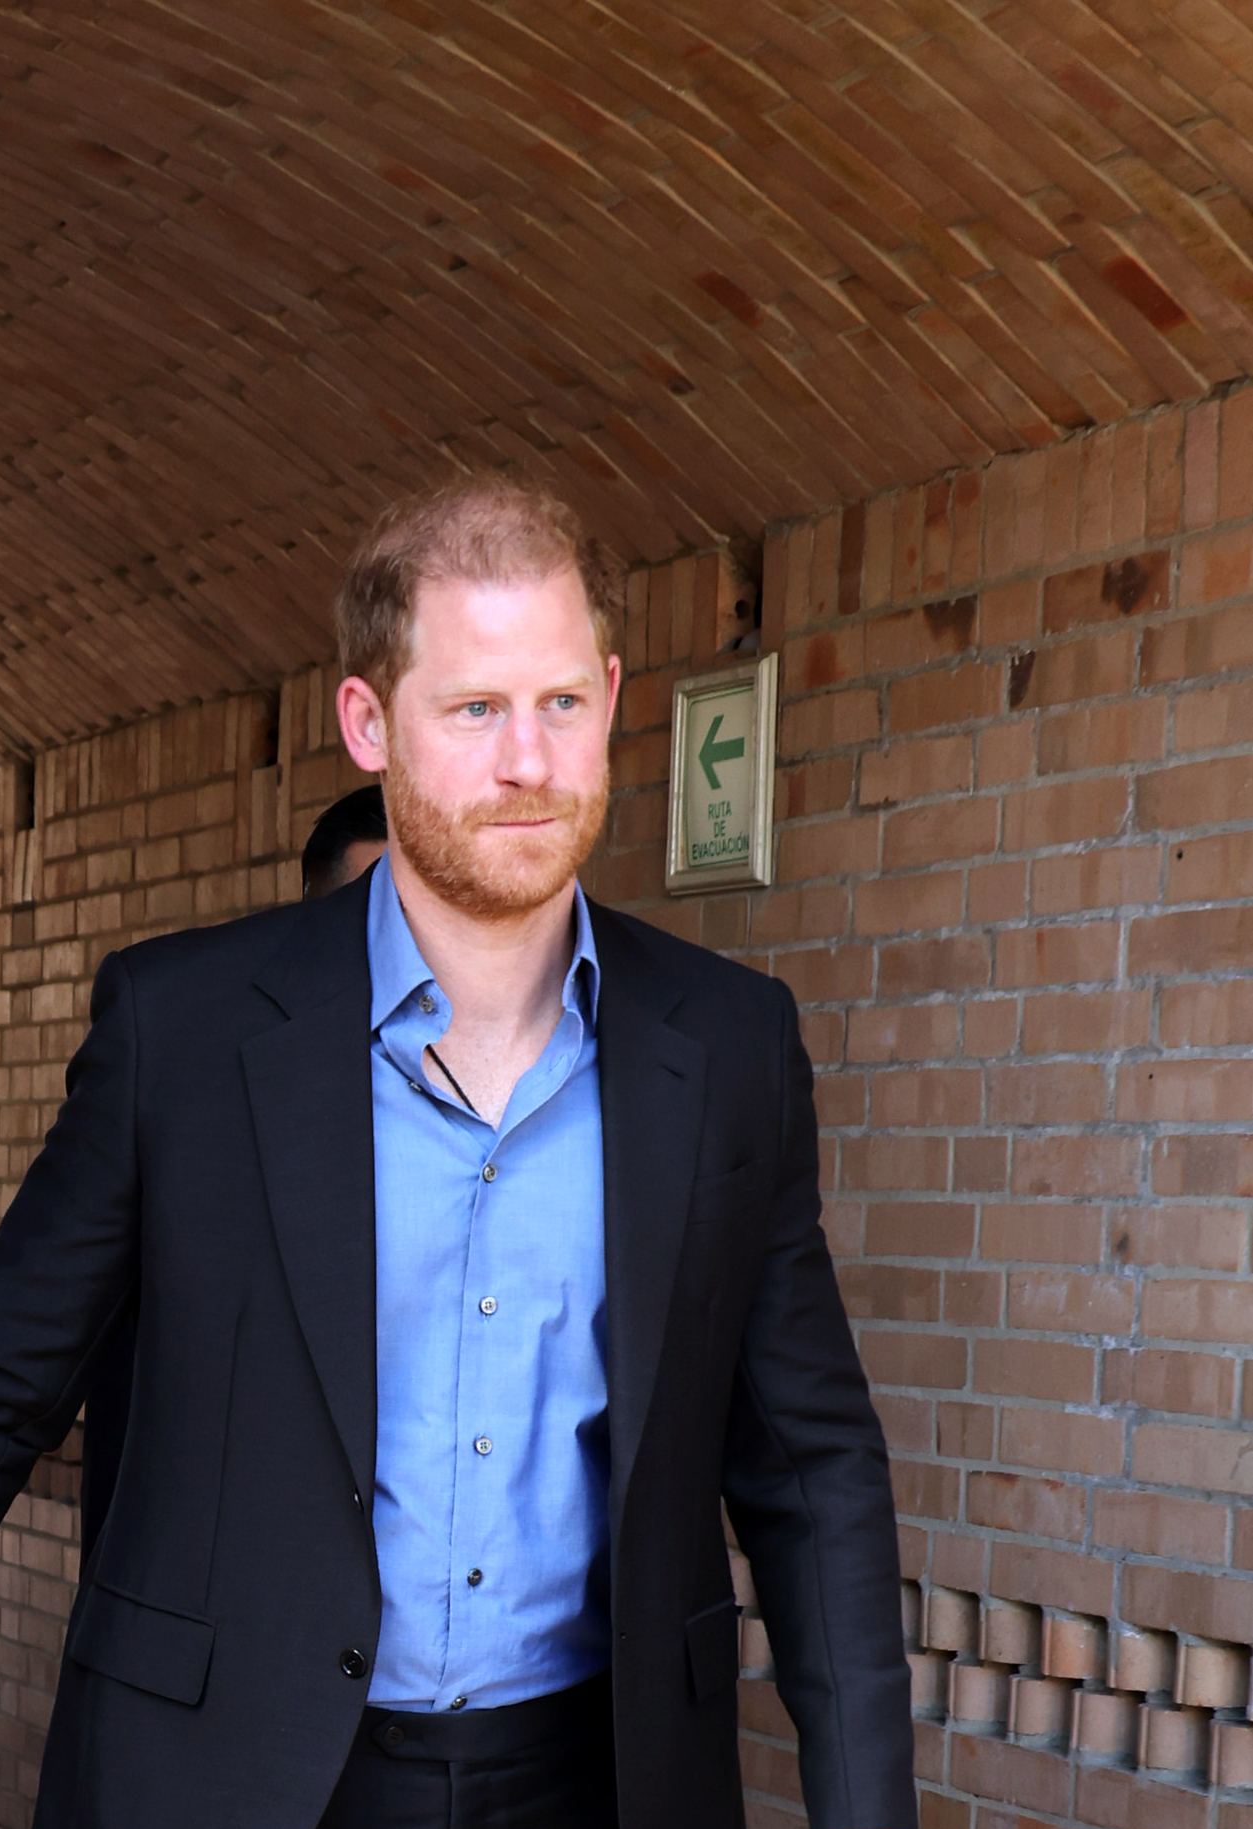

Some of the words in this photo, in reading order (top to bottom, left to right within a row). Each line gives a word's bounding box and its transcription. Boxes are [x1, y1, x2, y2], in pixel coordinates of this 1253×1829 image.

[708, 800, 732, 821] RUTA
[713, 820, 726, 838] DE
[691, 831, 750, 861] EVACUACIÓN
